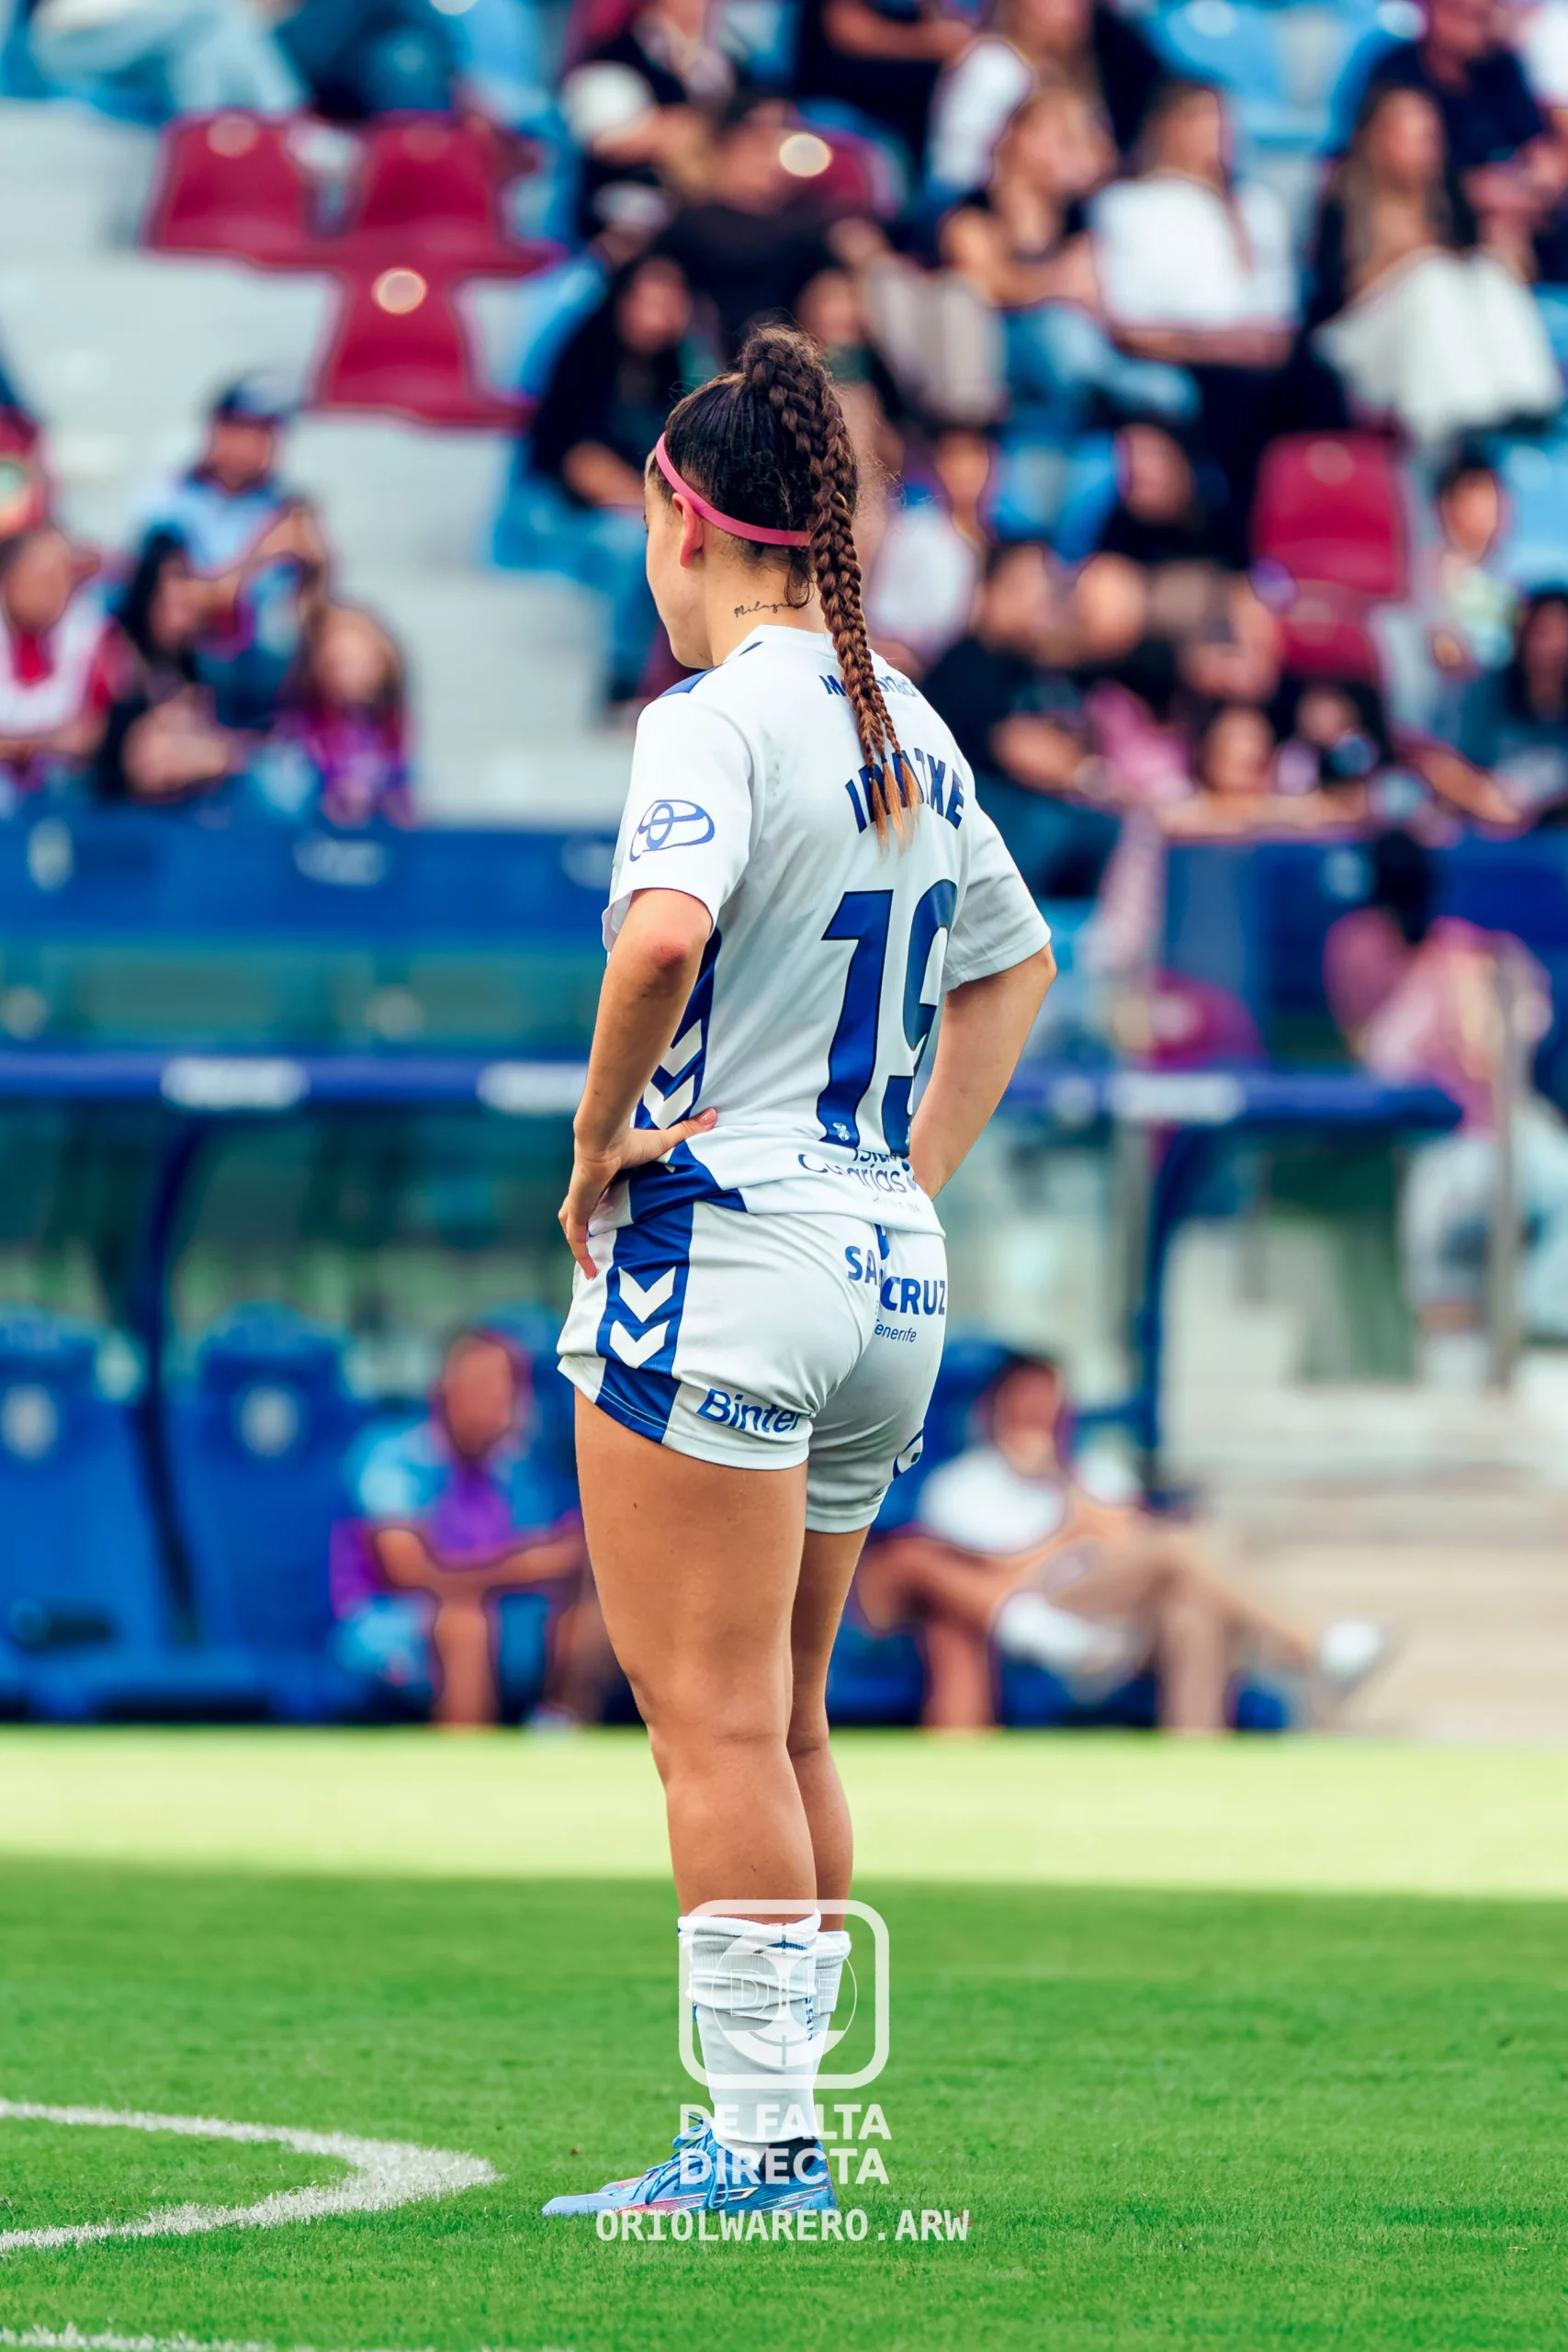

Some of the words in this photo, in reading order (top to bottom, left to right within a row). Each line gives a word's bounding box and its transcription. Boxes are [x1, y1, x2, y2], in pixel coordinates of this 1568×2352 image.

[816, 878, 957, 1159] 19
[880, 1276, 946, 1316] CRUZ
[874, 1318, 918, 1343] enerife
